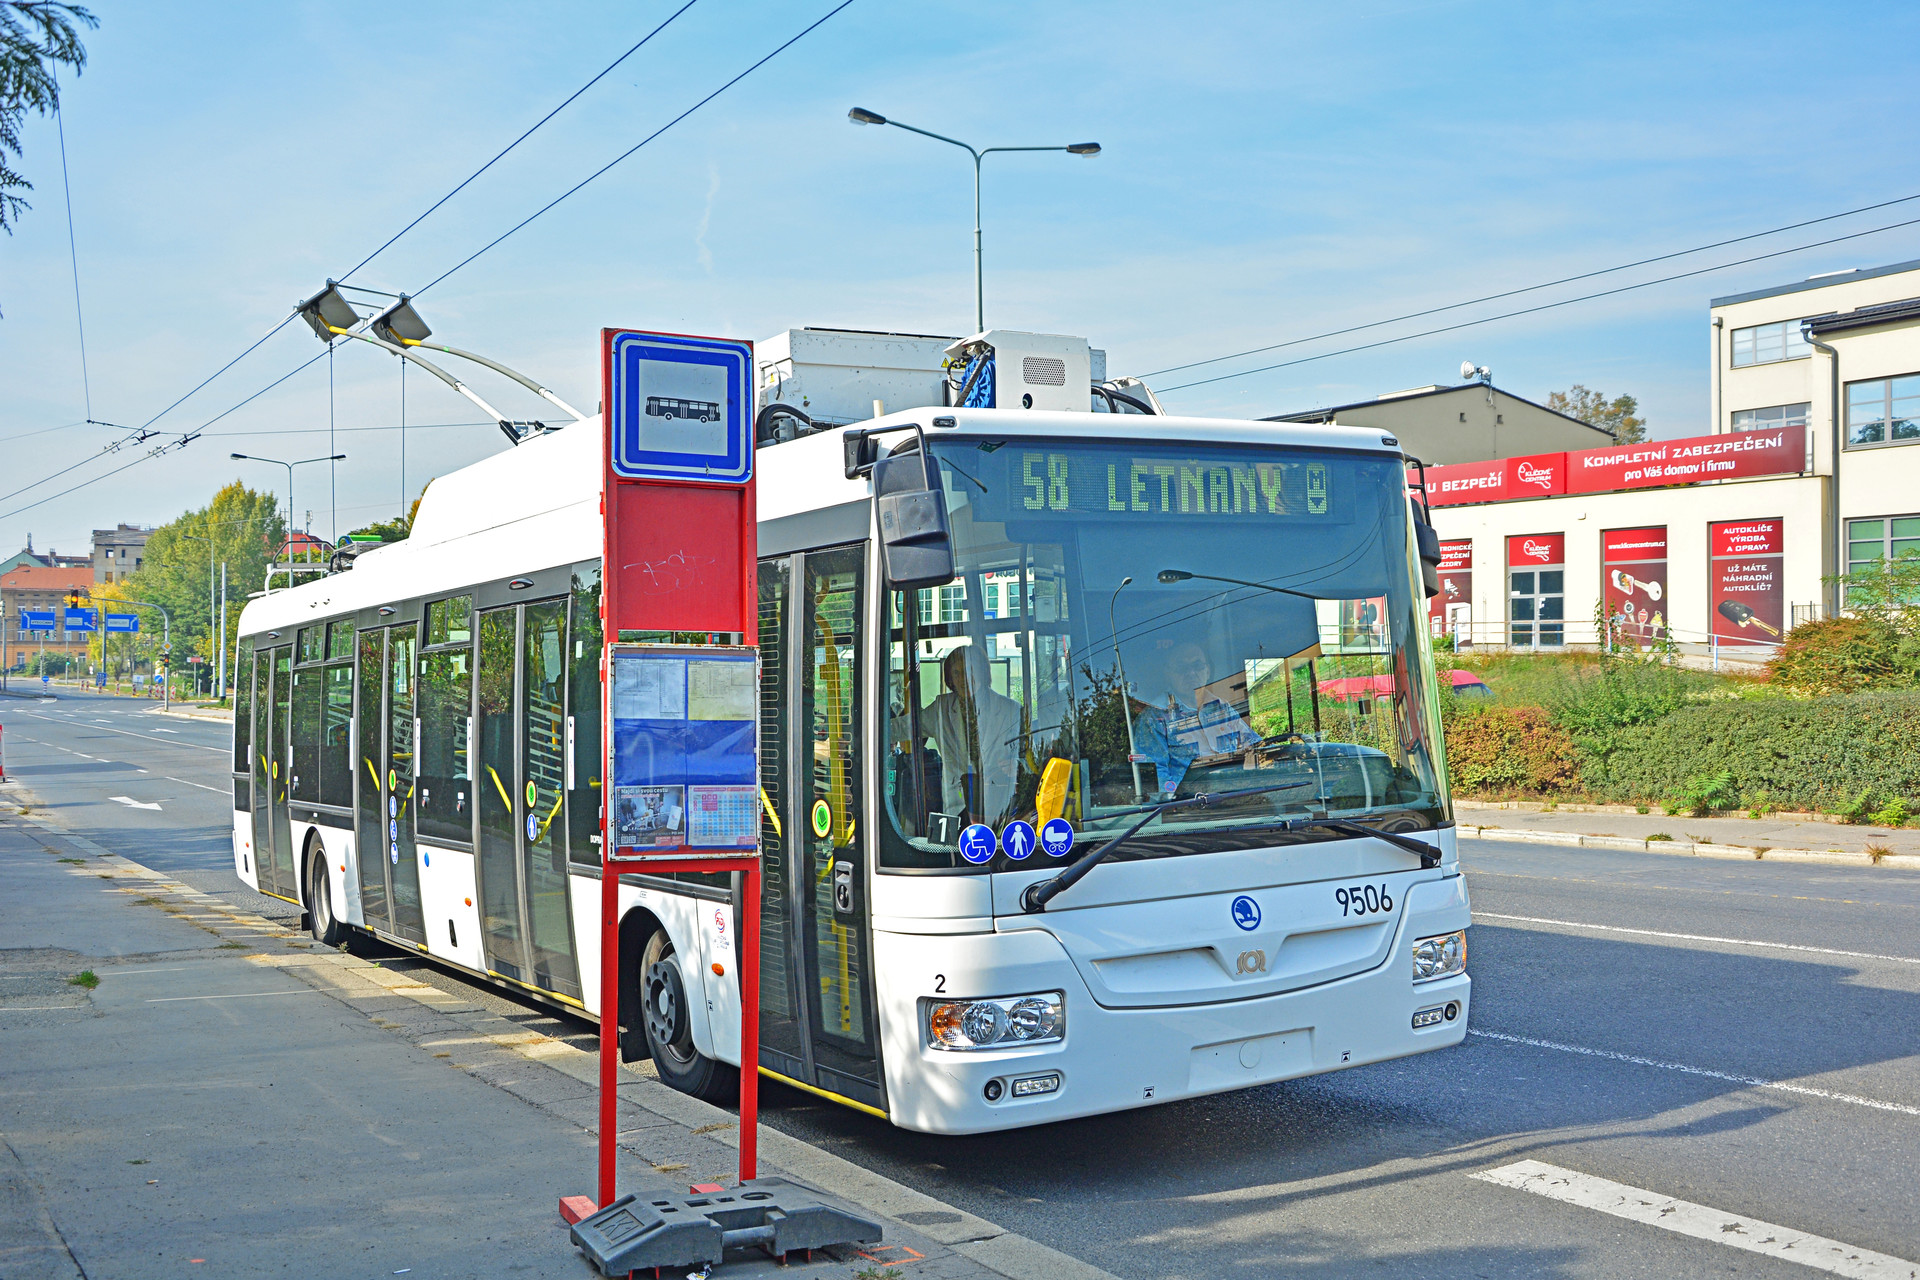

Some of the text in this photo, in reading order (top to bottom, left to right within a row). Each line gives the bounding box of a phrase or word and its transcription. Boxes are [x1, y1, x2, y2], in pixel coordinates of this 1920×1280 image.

[1672, 432, 1783, 459] ZABEZPEČENÍ
[1624, 469, 1642, 482] pro
[1643, 465, 1663, 478] Váš
[1665, 463, 1701, 477] domov
[1706, 458, 1736, 472] firmu
[1022, 452, 1281, 513] 58 LETŇANY
[1442, 471, 1503, 492] BEZPEČÍ
[1525, 475, 1552, 483] CENTRUM
[1723, 524, 1773, 535] AUTOKLÍČE
[1730, 535, 1766, 543] VÝROBA
[1735, 543, 1770, 552] OPRAVY
[1727, 563, 1768, 573] UŽ MÁTE
[1722, 572, 1773, 583] NÁHRADNÍ
[1723, 582, 1772, 592] AUTOKLÍČ?
[938, 817, 948, 843] 1
[1335, 883, 1393, 917] 9506
[935, 973, 946, 994] 2
